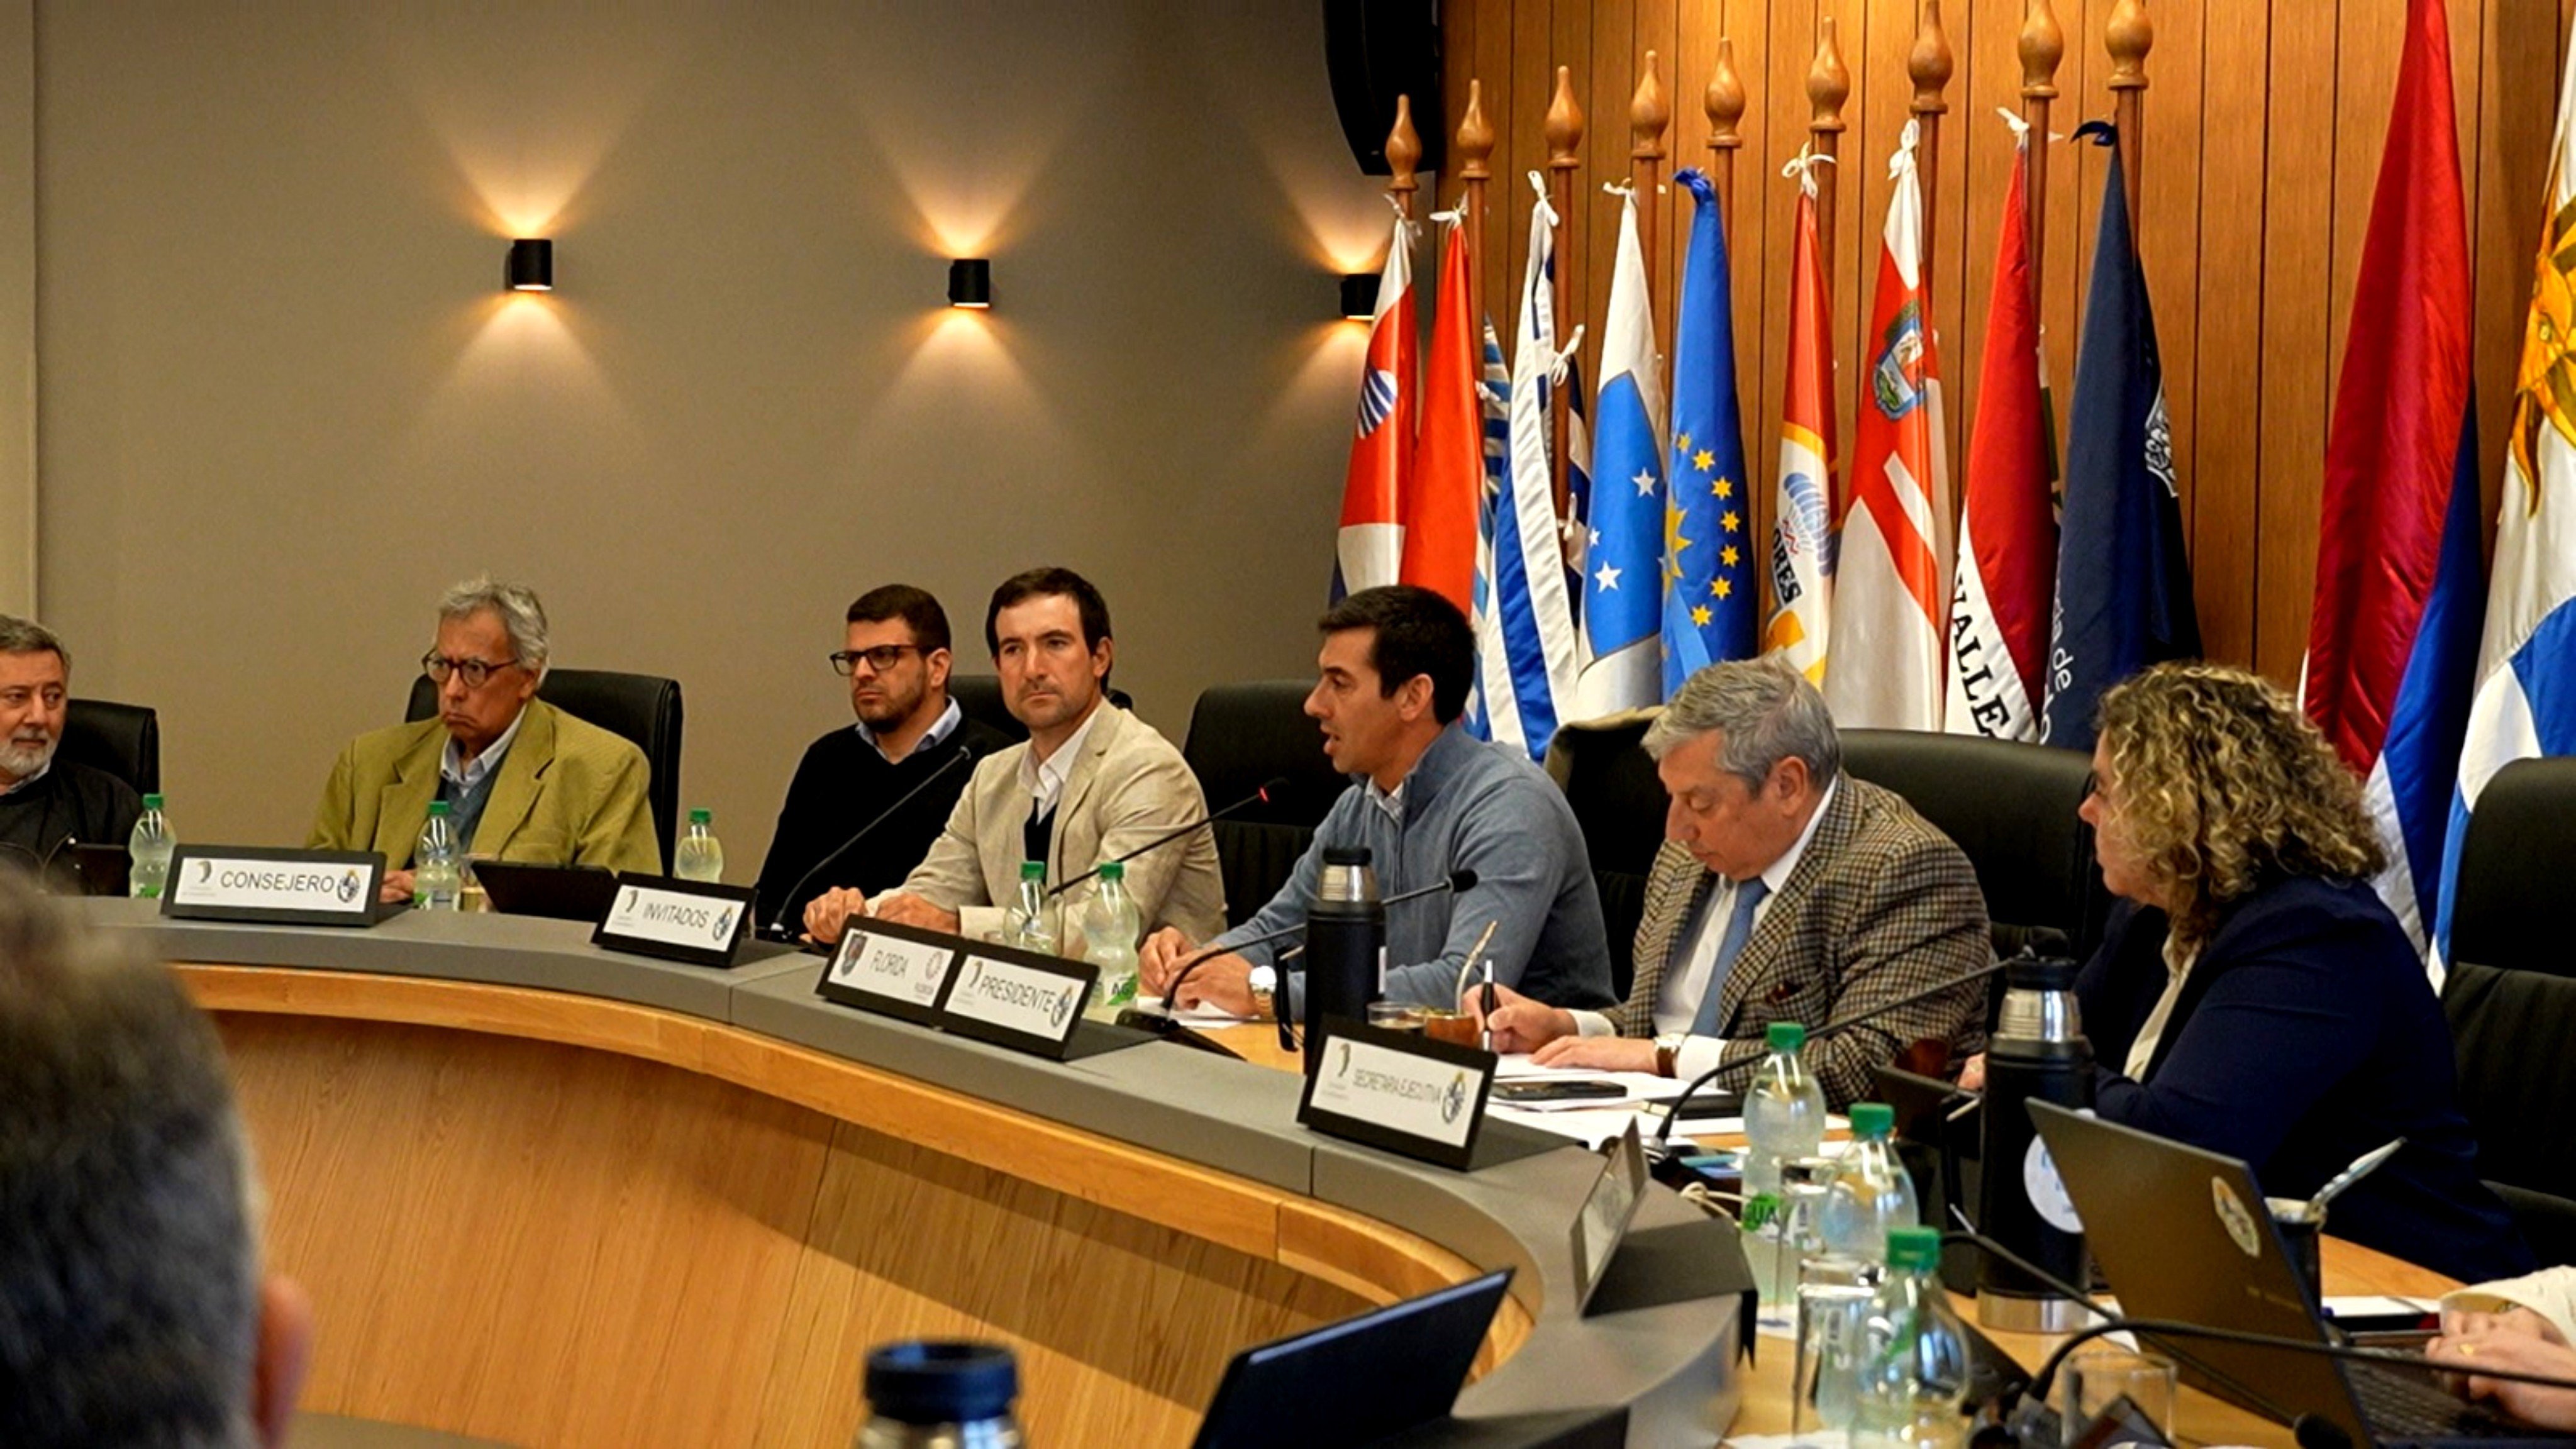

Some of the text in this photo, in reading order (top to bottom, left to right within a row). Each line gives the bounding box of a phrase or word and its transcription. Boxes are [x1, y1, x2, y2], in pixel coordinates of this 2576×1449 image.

[220, 870, 335, 894] CONSEJERO
[642, 902, 710, 930] INVITADOS
[977, 974, 1057, 1014] PRESIDENTE
